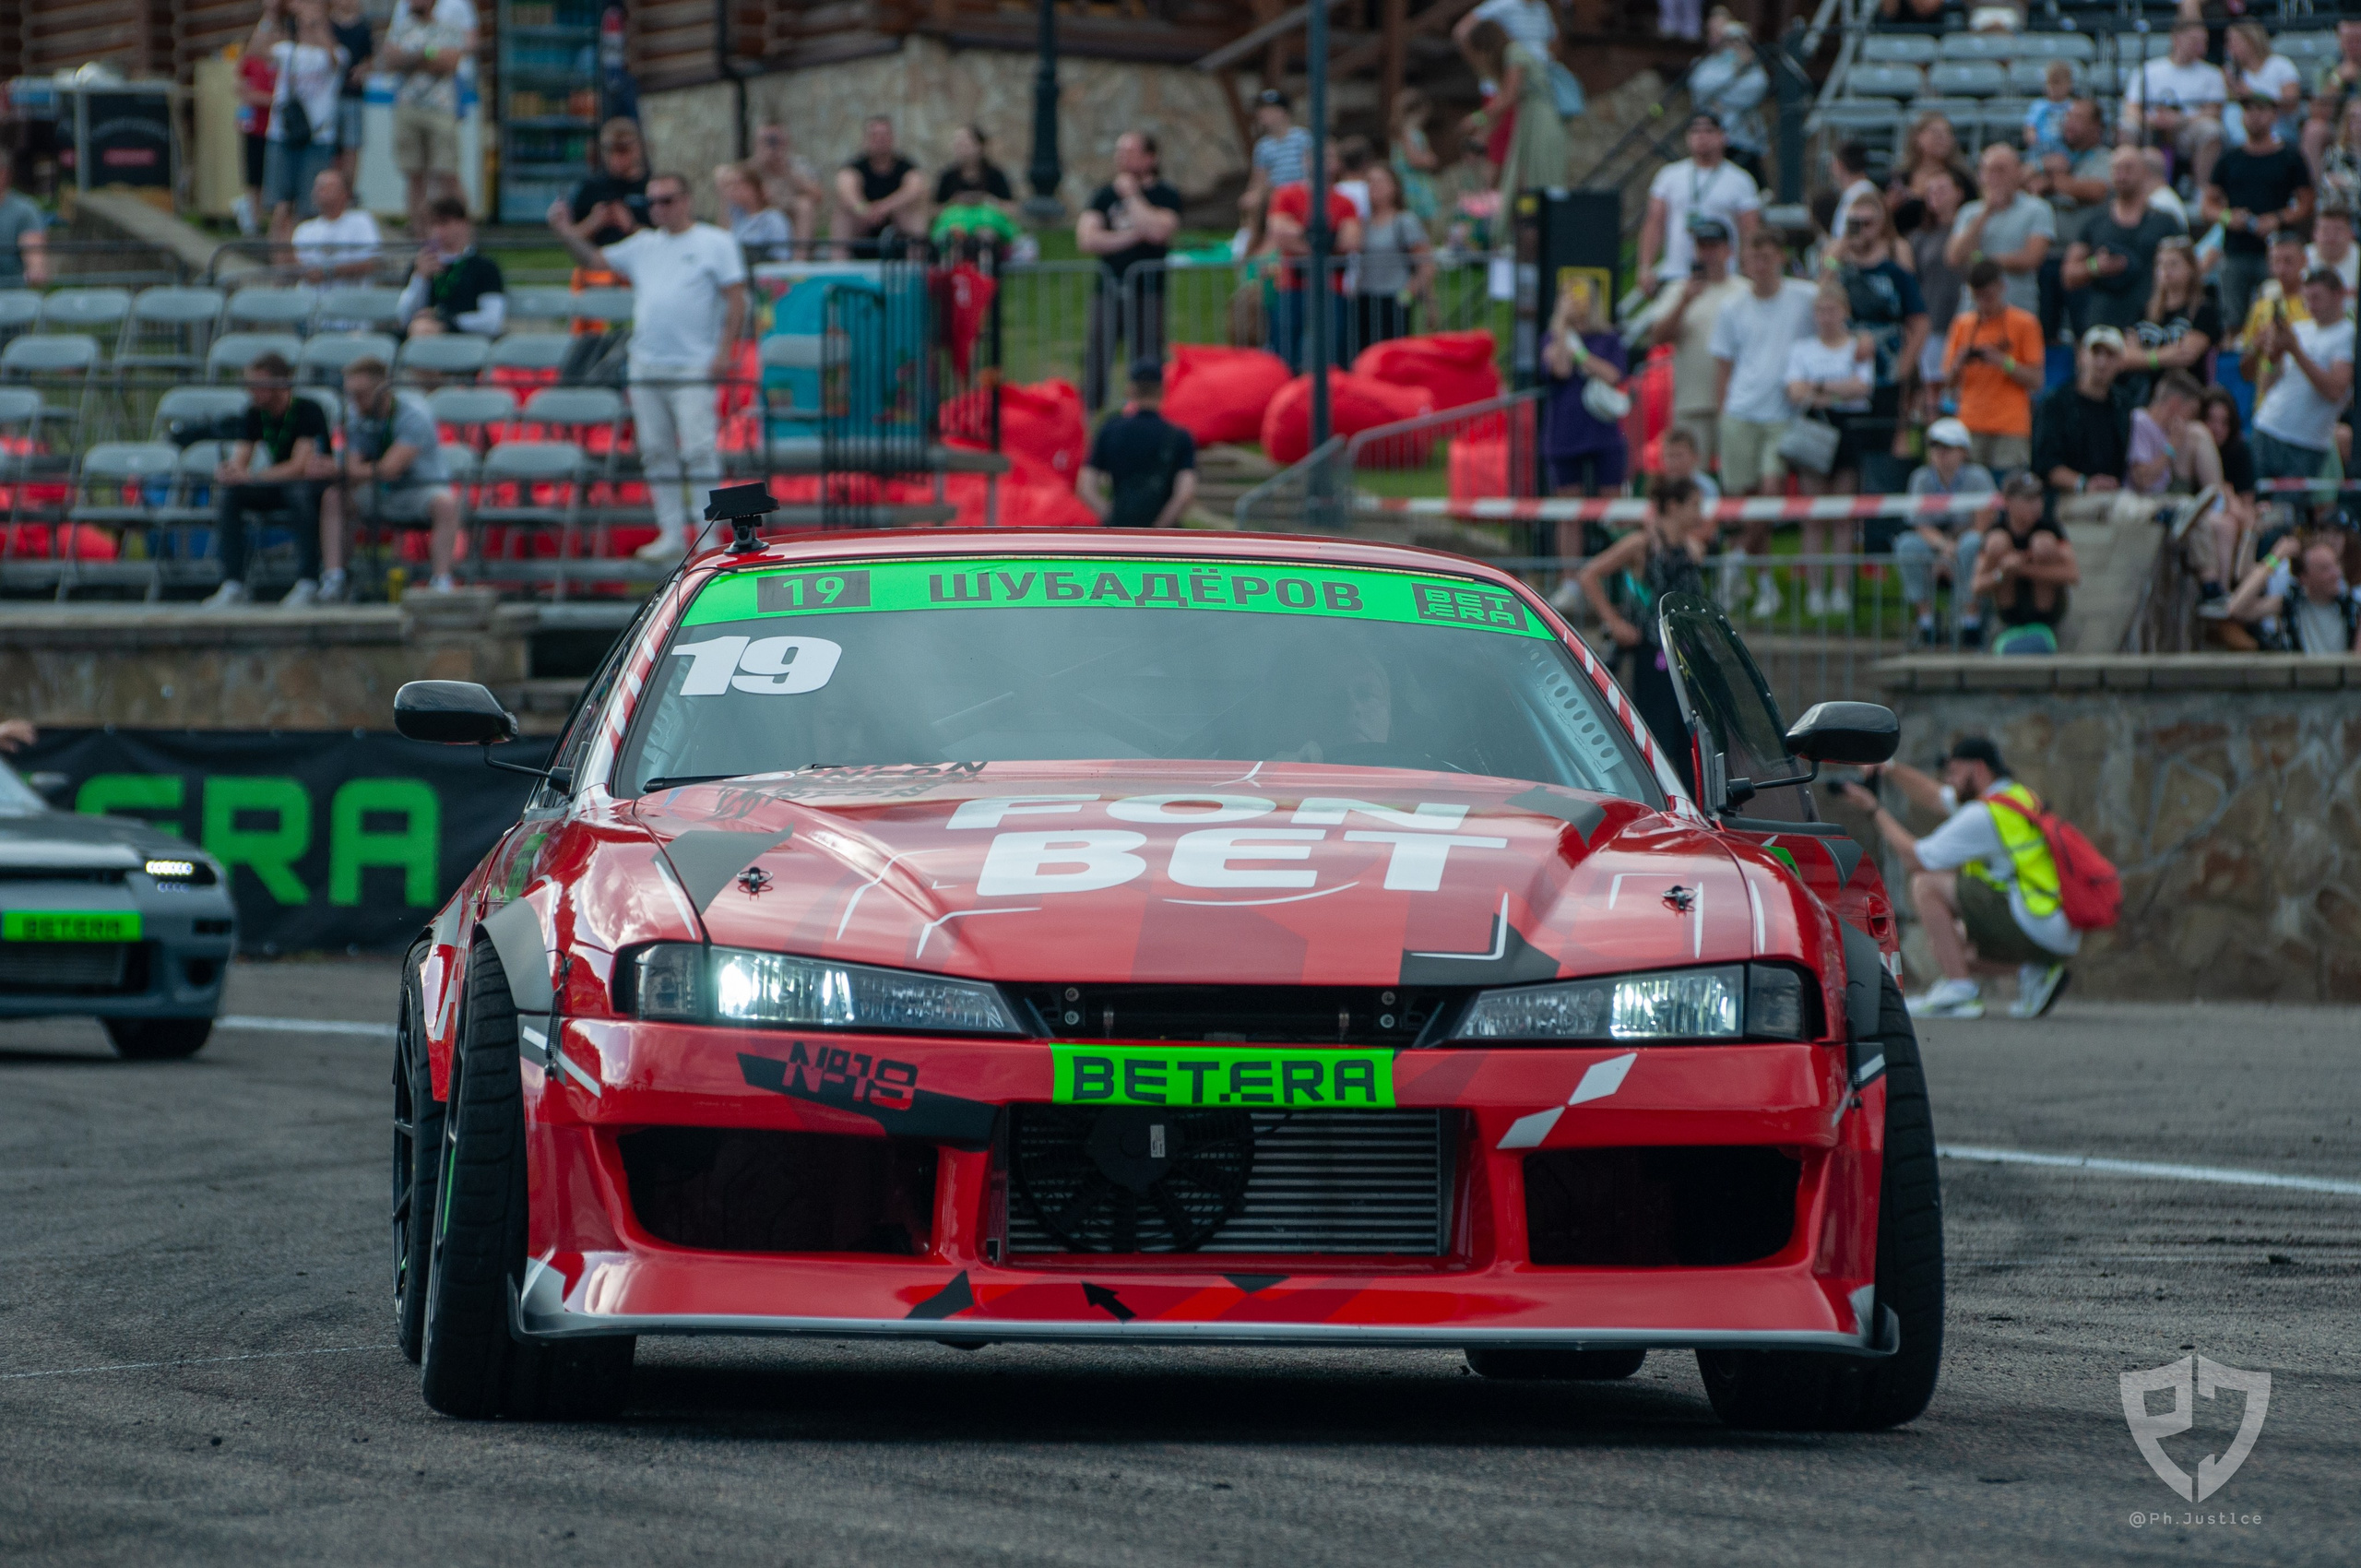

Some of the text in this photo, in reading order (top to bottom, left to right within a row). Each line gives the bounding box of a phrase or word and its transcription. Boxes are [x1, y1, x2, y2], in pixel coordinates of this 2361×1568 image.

[783, 576, 845, 606] 19
[929, 568, 1364, 611] ШУБАДЁРОВ
[1423, 588, 1510, 611] BET
[670, 636, 843, 695] 19
[945, 793, 1471, 830] FON
[976, 828, 1508, 897] BET
[1072, 1055, 1377, 1105] BET.ERA
